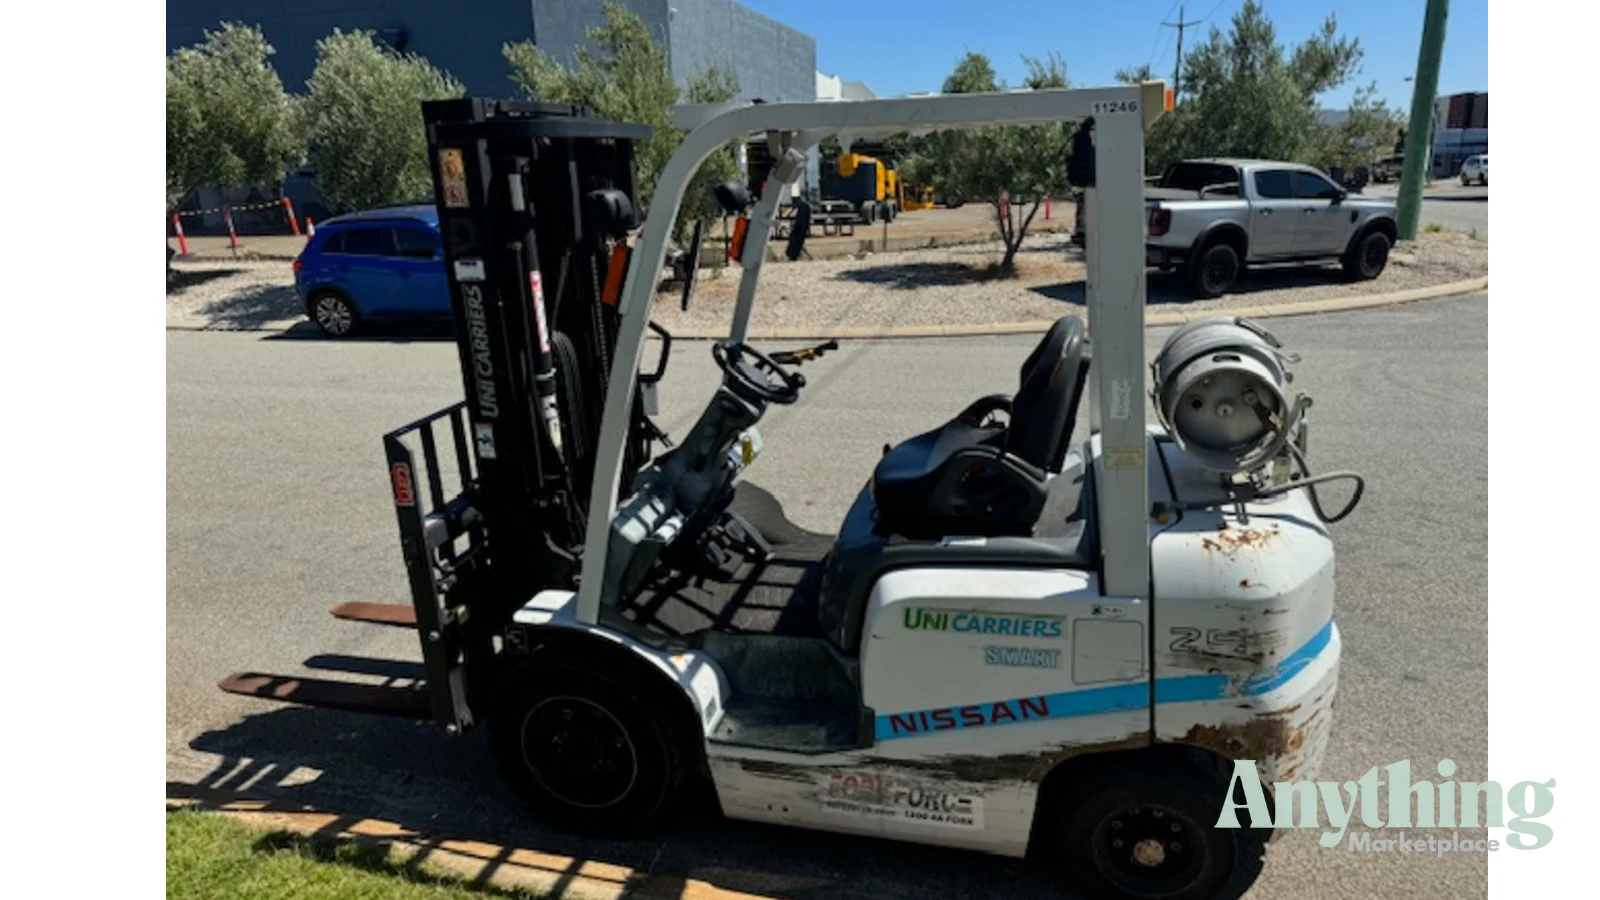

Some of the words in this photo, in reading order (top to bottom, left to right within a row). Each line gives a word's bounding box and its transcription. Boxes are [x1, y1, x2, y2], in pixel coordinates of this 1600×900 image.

[1094, 101, 1138, 113] 11246
[984, 645, 1062, 669] SMART
[890, 696, 1050, 734] NISSAN
